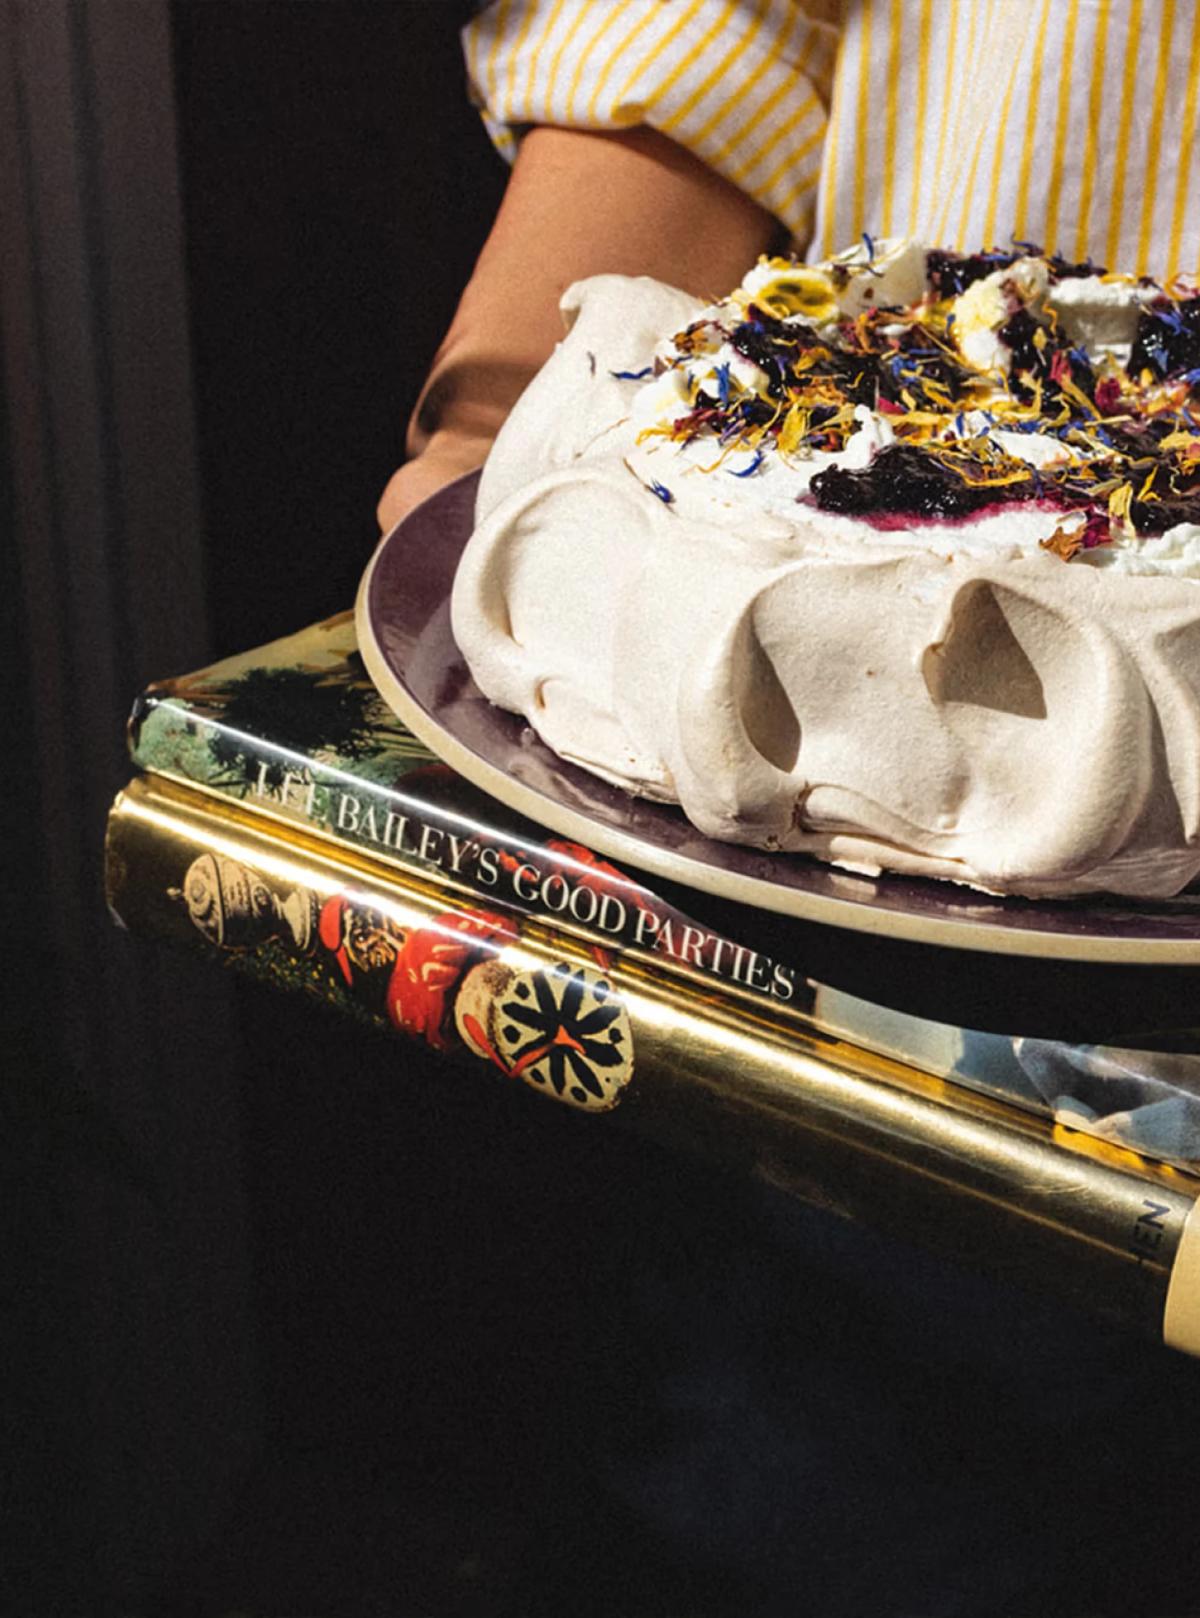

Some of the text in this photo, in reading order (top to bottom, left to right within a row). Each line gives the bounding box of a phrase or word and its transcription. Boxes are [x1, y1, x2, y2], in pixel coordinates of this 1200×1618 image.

[256, 761, 795, 1000] LEE BAILEY'S GOOD PARTIES
